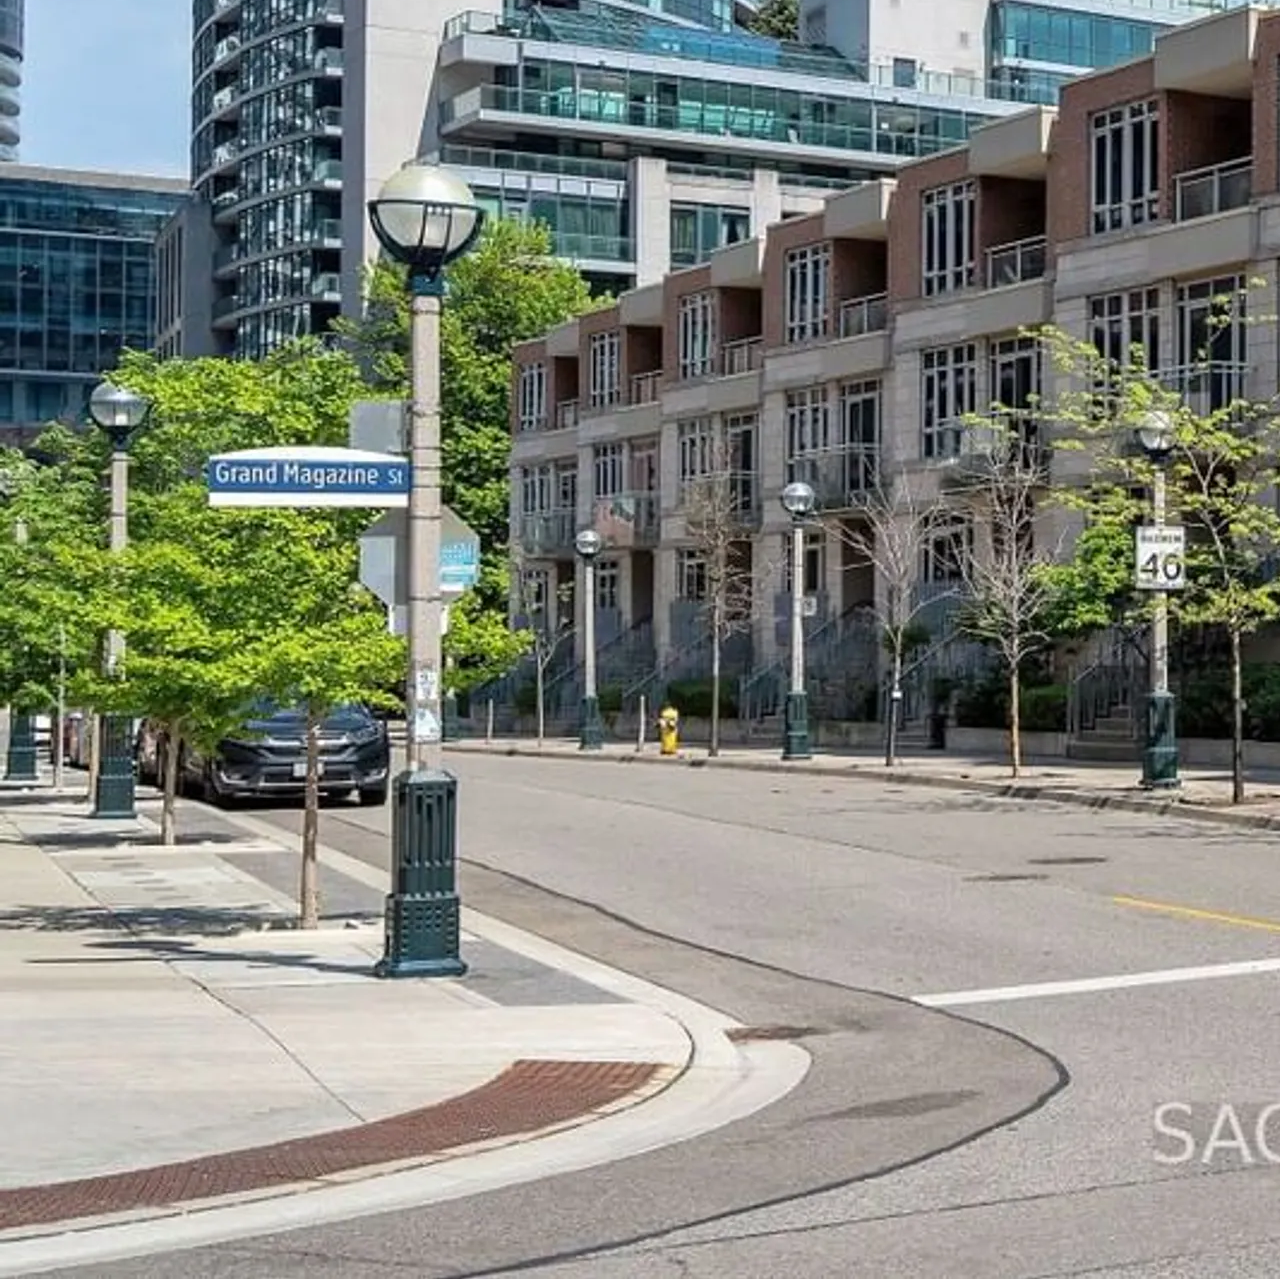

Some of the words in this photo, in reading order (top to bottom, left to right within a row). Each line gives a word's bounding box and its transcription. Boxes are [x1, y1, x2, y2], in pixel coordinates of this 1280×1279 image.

[215, 462, 278, 484] Grand
[283, 463, 378, 489] Magazine
[388, 468, 402, 484] St
[1140, 552, 1182, 580] 40
